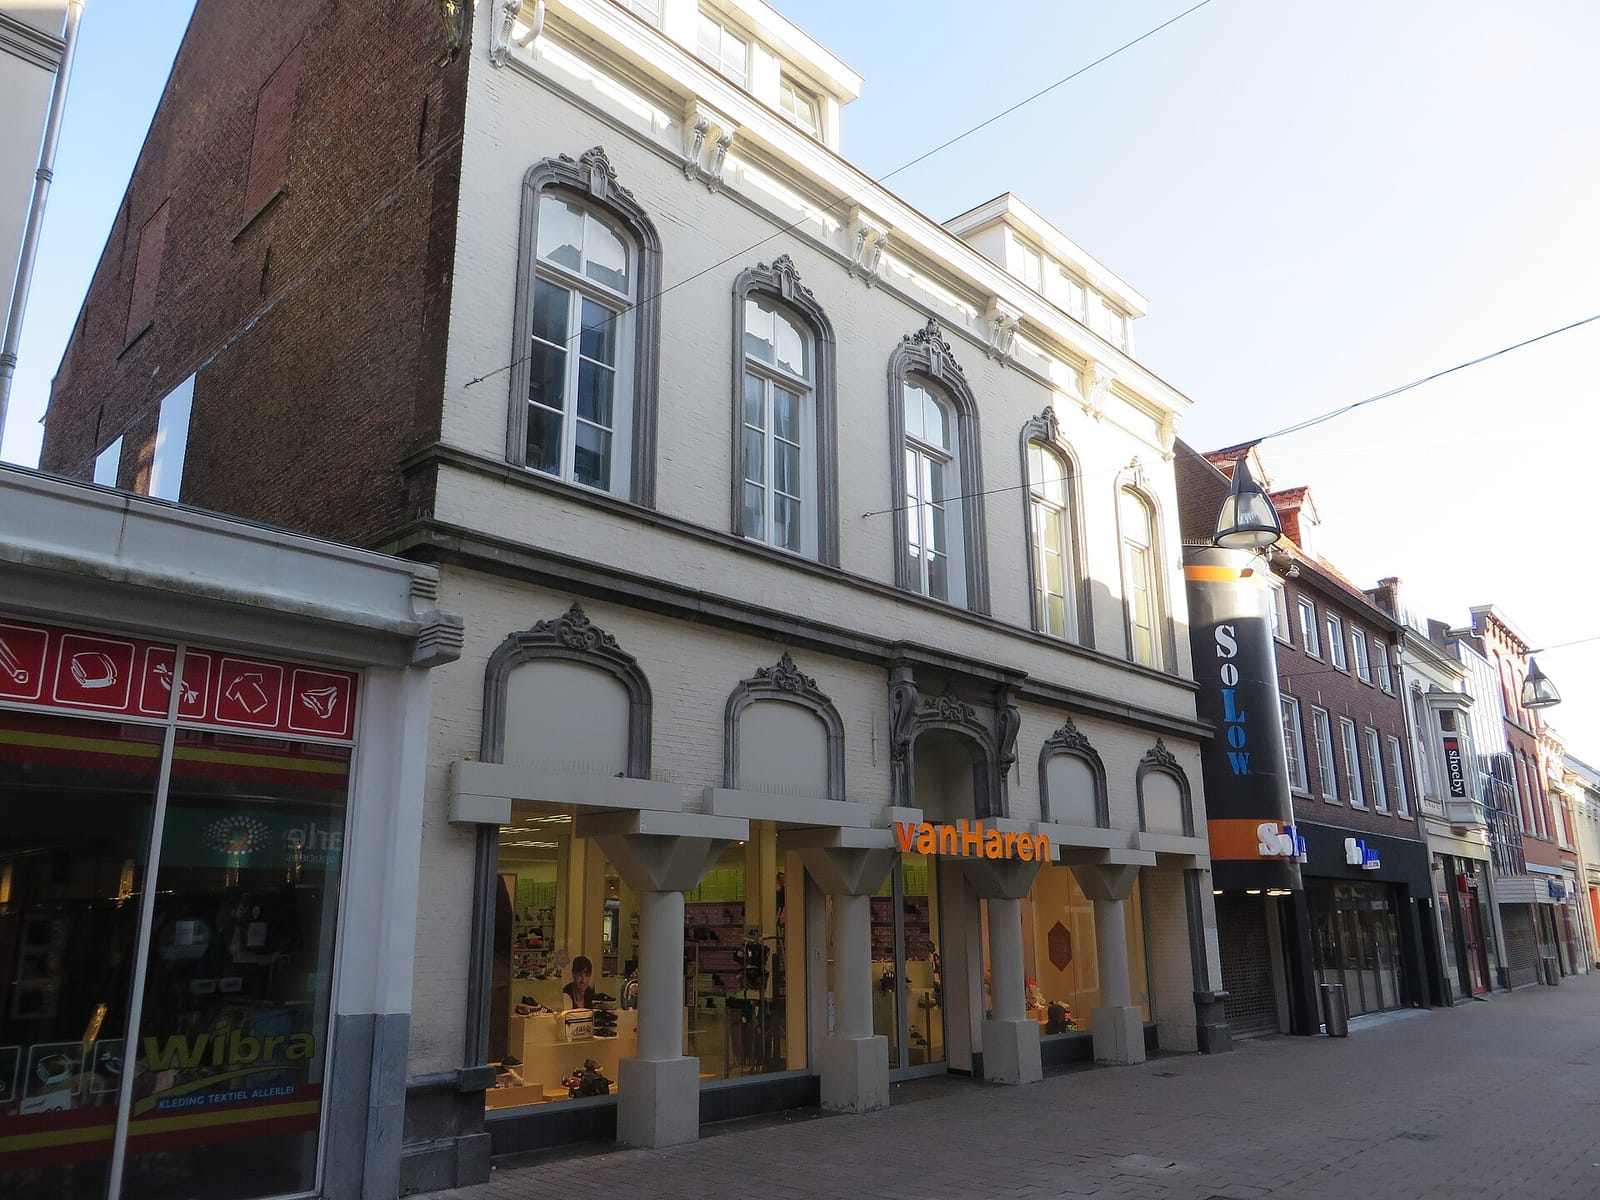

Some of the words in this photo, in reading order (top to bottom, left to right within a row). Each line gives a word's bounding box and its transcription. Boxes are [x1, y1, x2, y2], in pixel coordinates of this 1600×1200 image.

[1449, 750, 1464, 795] shoeby
[895, 818, 1051, 862] vanHaren
[158, 1095, 206, 1110] KLEDING
[208, 1090, 249, 1104] TEXTIEL
[252, 1085, 295, 1099] ALLERLEI
